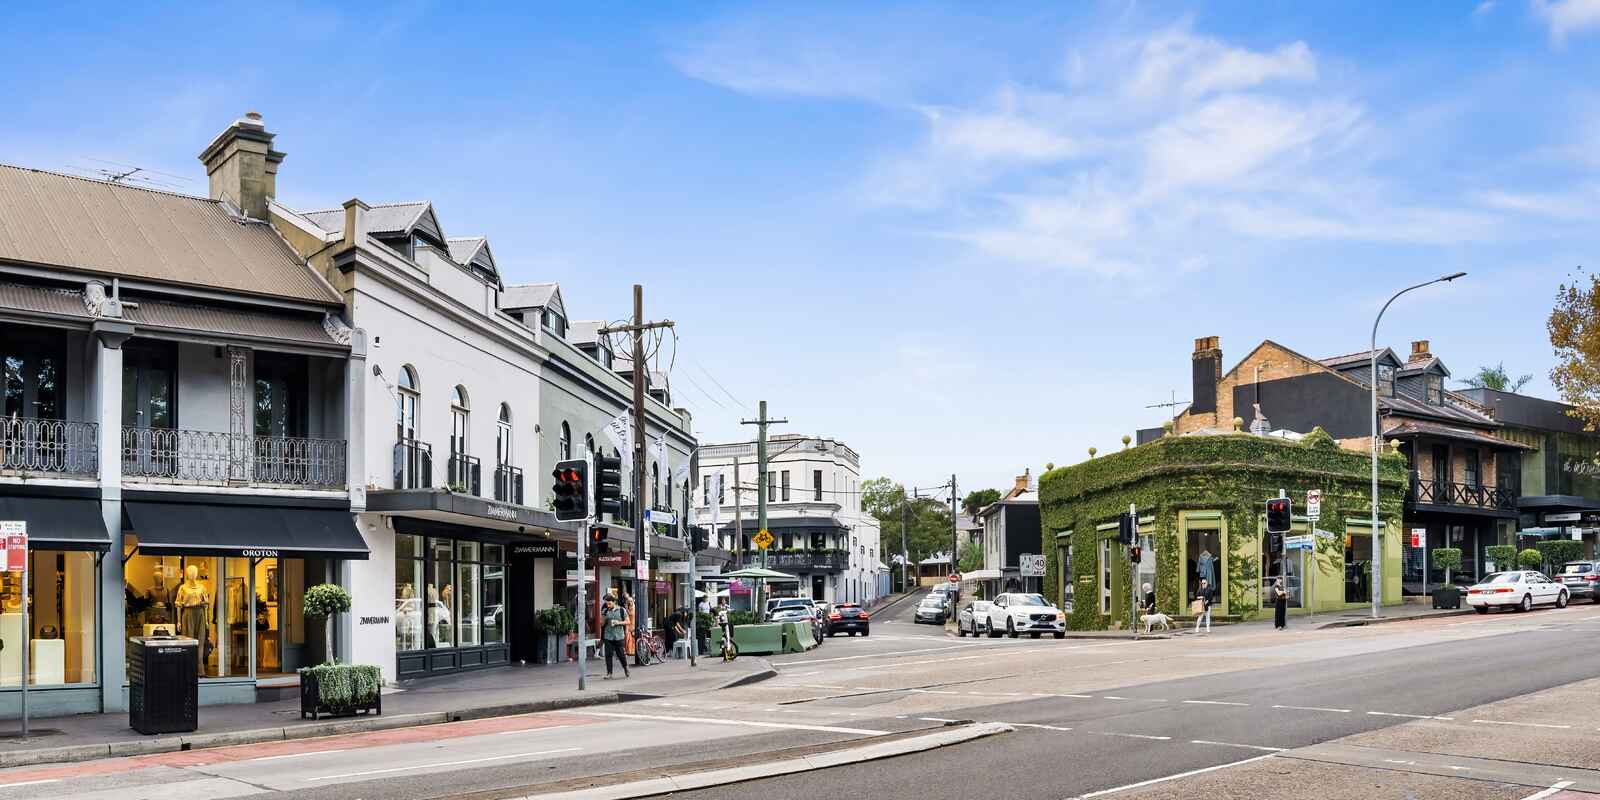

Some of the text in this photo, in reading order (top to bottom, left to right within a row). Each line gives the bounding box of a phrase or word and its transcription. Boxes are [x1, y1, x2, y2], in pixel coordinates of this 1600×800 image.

[487, 505, 517, 519] ZIMMERMANN
[242, 549, 278, 557] OROTON
[514, 545, 555, 553] ZIMMERMANN
[1035, 559, 1045, 567] 40
